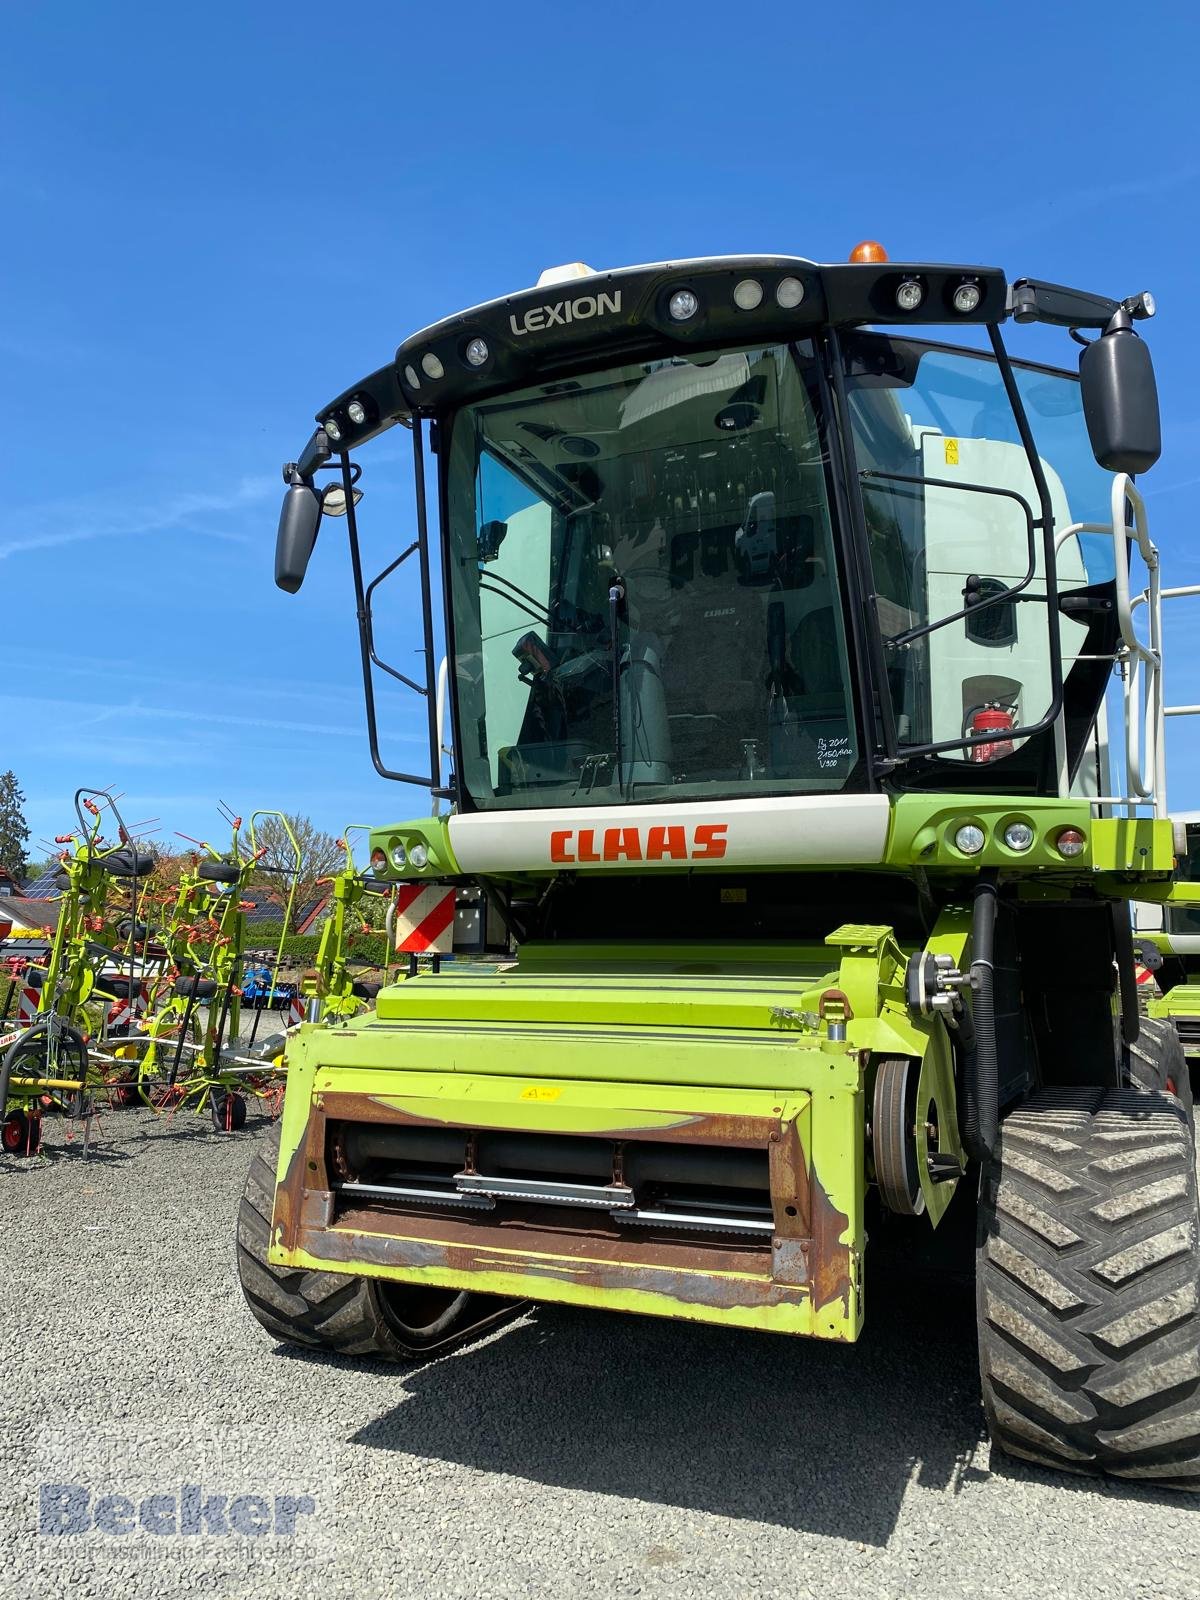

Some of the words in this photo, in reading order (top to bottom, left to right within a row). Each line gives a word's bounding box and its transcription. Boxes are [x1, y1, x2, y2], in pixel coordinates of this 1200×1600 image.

[510, 291, 621, 335] LEXION
[704, 608, 736, 617] CLAAS
[829, 738, 848, 747] 2011
[551, 825, 728, 862] CLAAS
